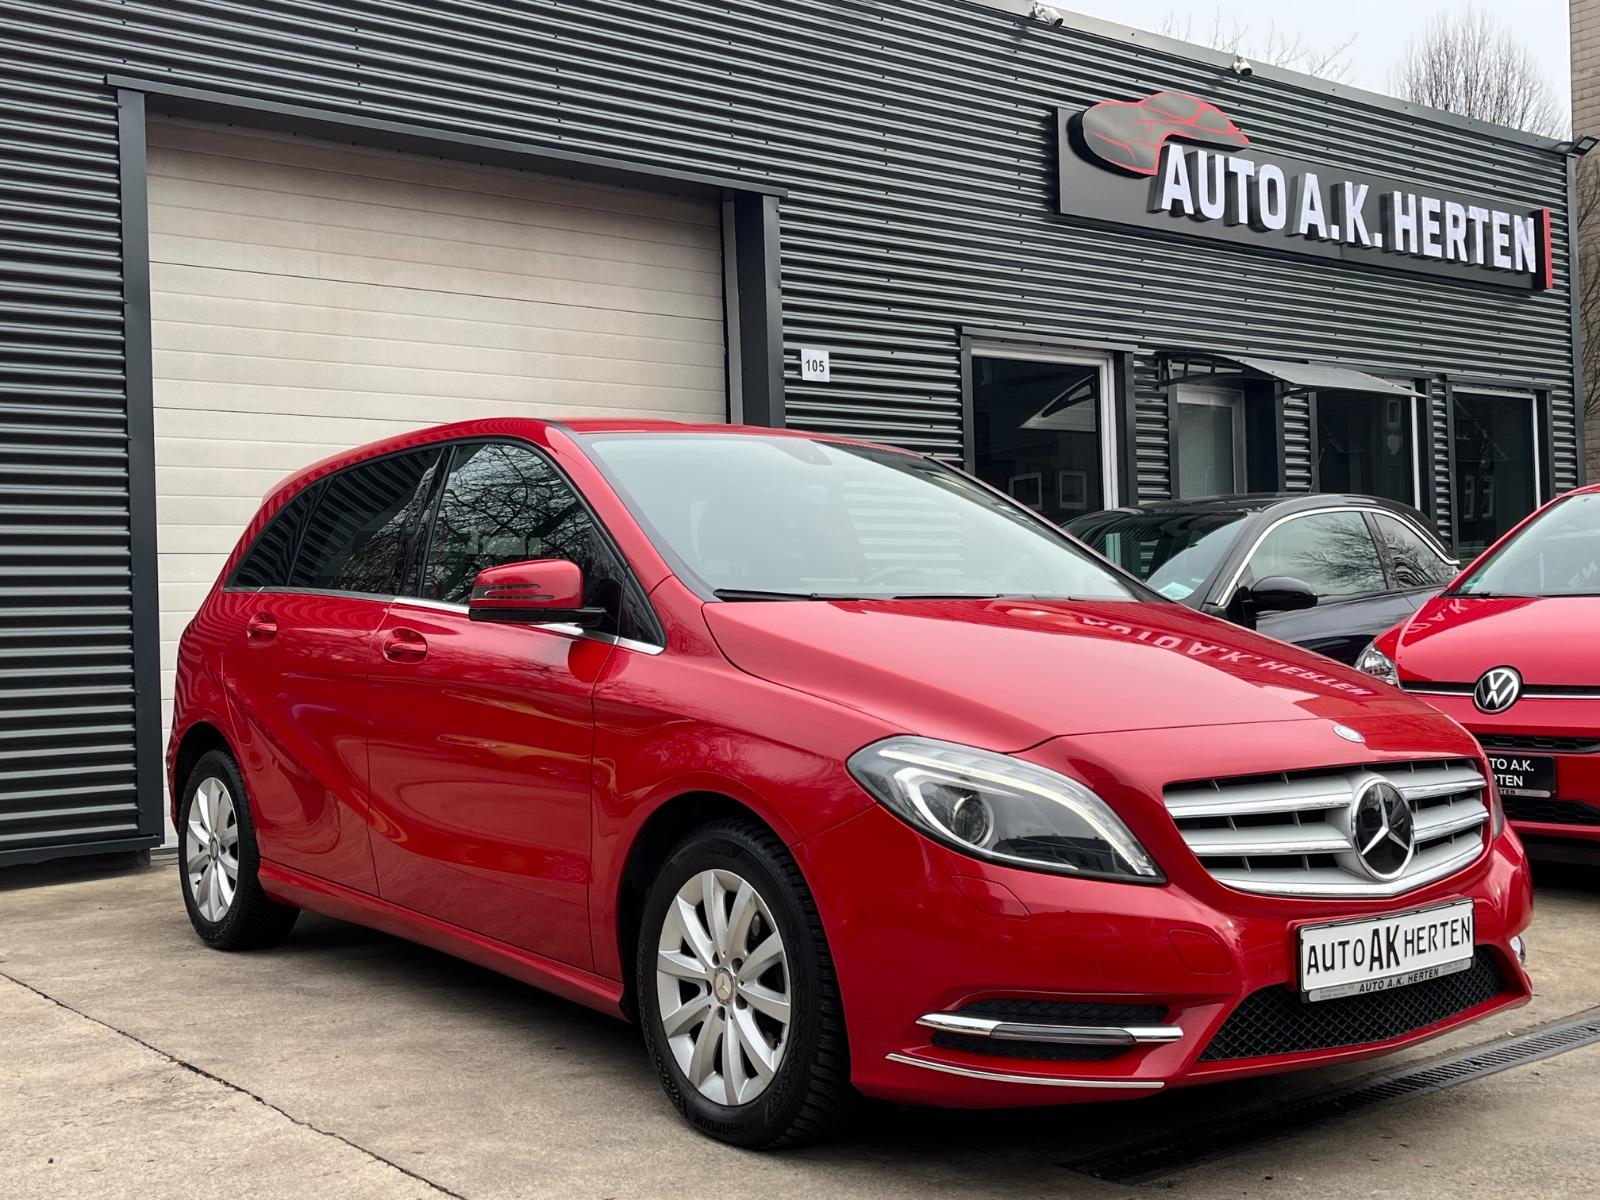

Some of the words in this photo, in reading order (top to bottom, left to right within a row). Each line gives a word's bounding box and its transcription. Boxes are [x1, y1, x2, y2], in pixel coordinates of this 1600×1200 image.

[1161, 143, 1287, 230] AUTO
[1299, 172, 1383, 248] A.K.
[1393, 190, 1537, 274] HERTEN
[805, 359, 825, 373] 105
[1489, 757, 1508, 770] TO
[1510, 759, 1535, 772] A.K.
[1494, 774, 1524, 787] TEN
[1306, 938, 1366, 976] AUTO
[1369, 924, 1401, 973] AK
[1404, 915, 1471, 958] HERTEN
[1359, 980, 1385, 993] AUTO
[1387, 977, 1405, 988] A.K.
[1408, 967, 1439, 983] HERTEN
